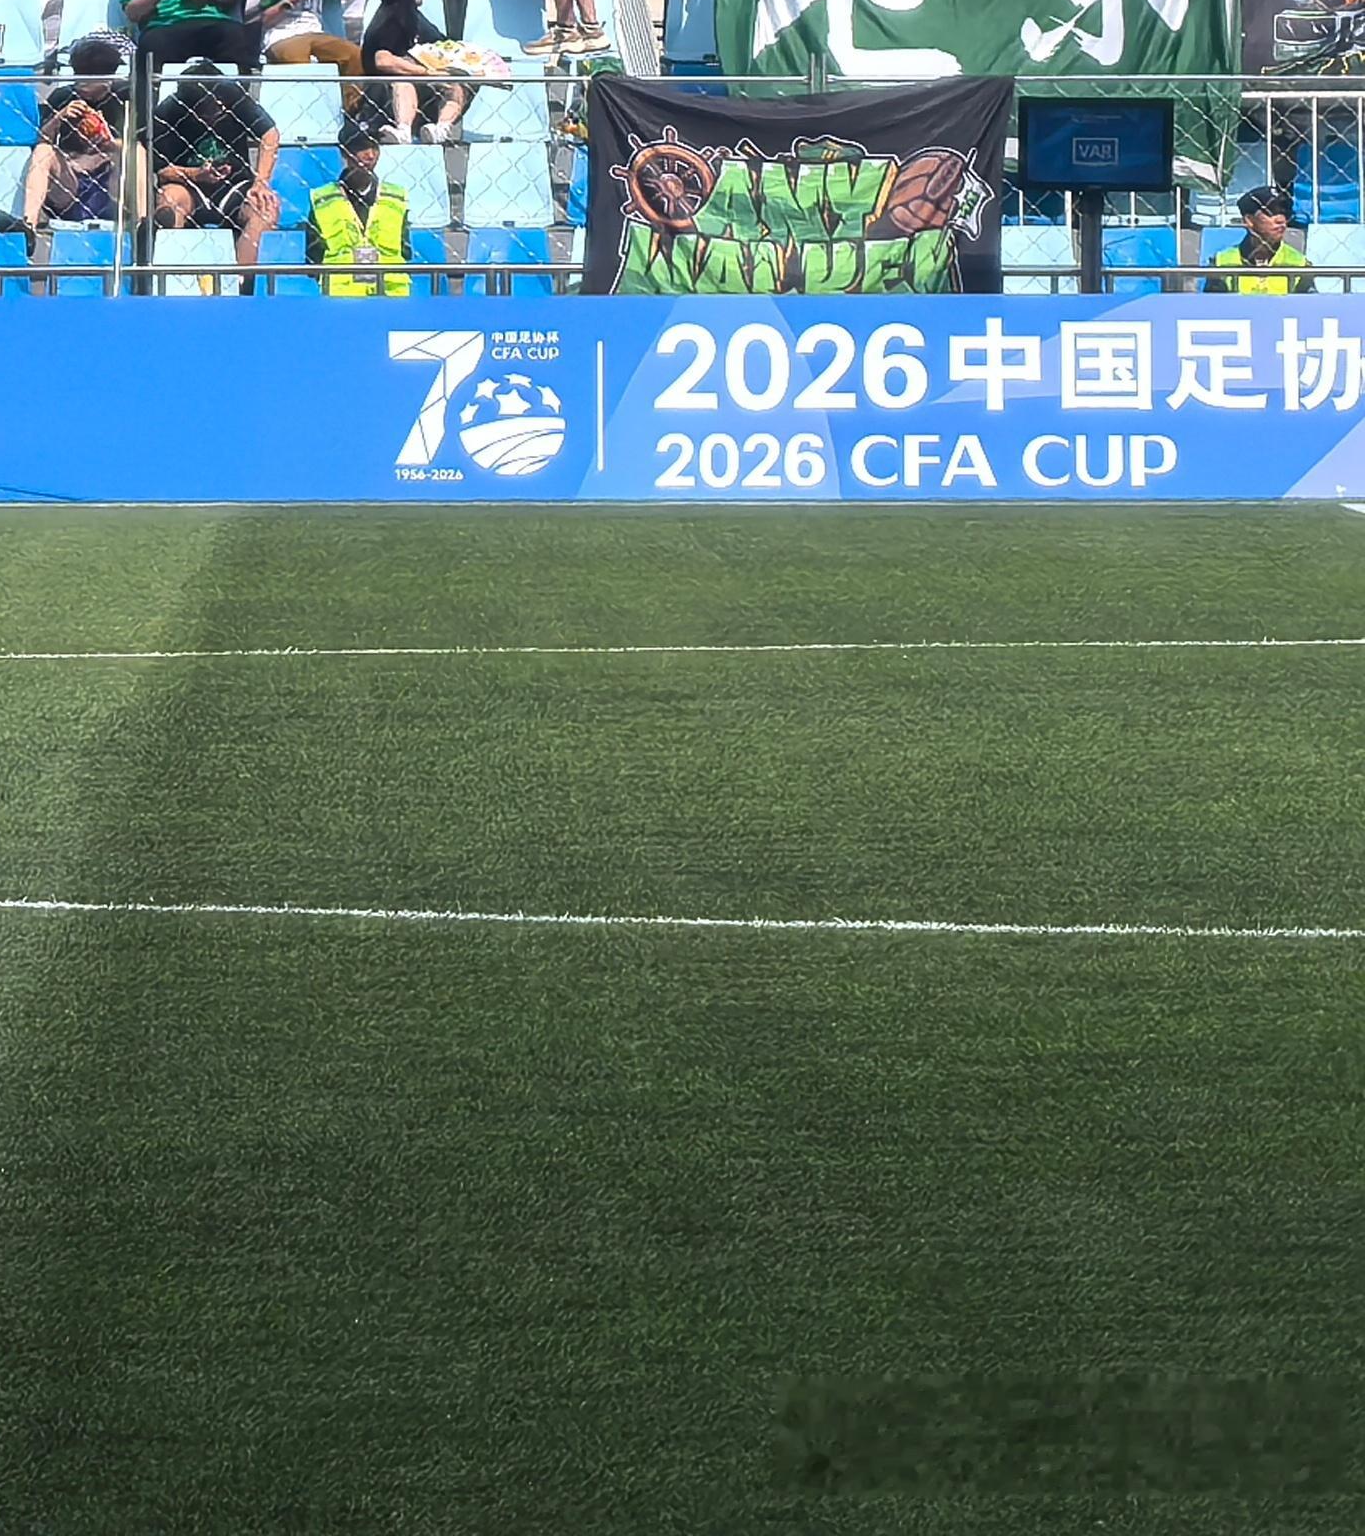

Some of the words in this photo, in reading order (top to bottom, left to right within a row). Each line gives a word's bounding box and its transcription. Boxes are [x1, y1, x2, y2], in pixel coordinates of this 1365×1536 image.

[1078, 144, 1112, 159] VAR
[694, 157, 898, 243] ANY
[491, 330, 560, 344] 中国足协杯
[491, 347, 523, 360] CFA
[528, 347, 560, 361] CUP
[654, 433, 827, 489] 2026
[850, 433, 999, 488] CFA
[1021, 433, 1179, 488] CUP
[395, 469, 464, 481] 1956-2026
